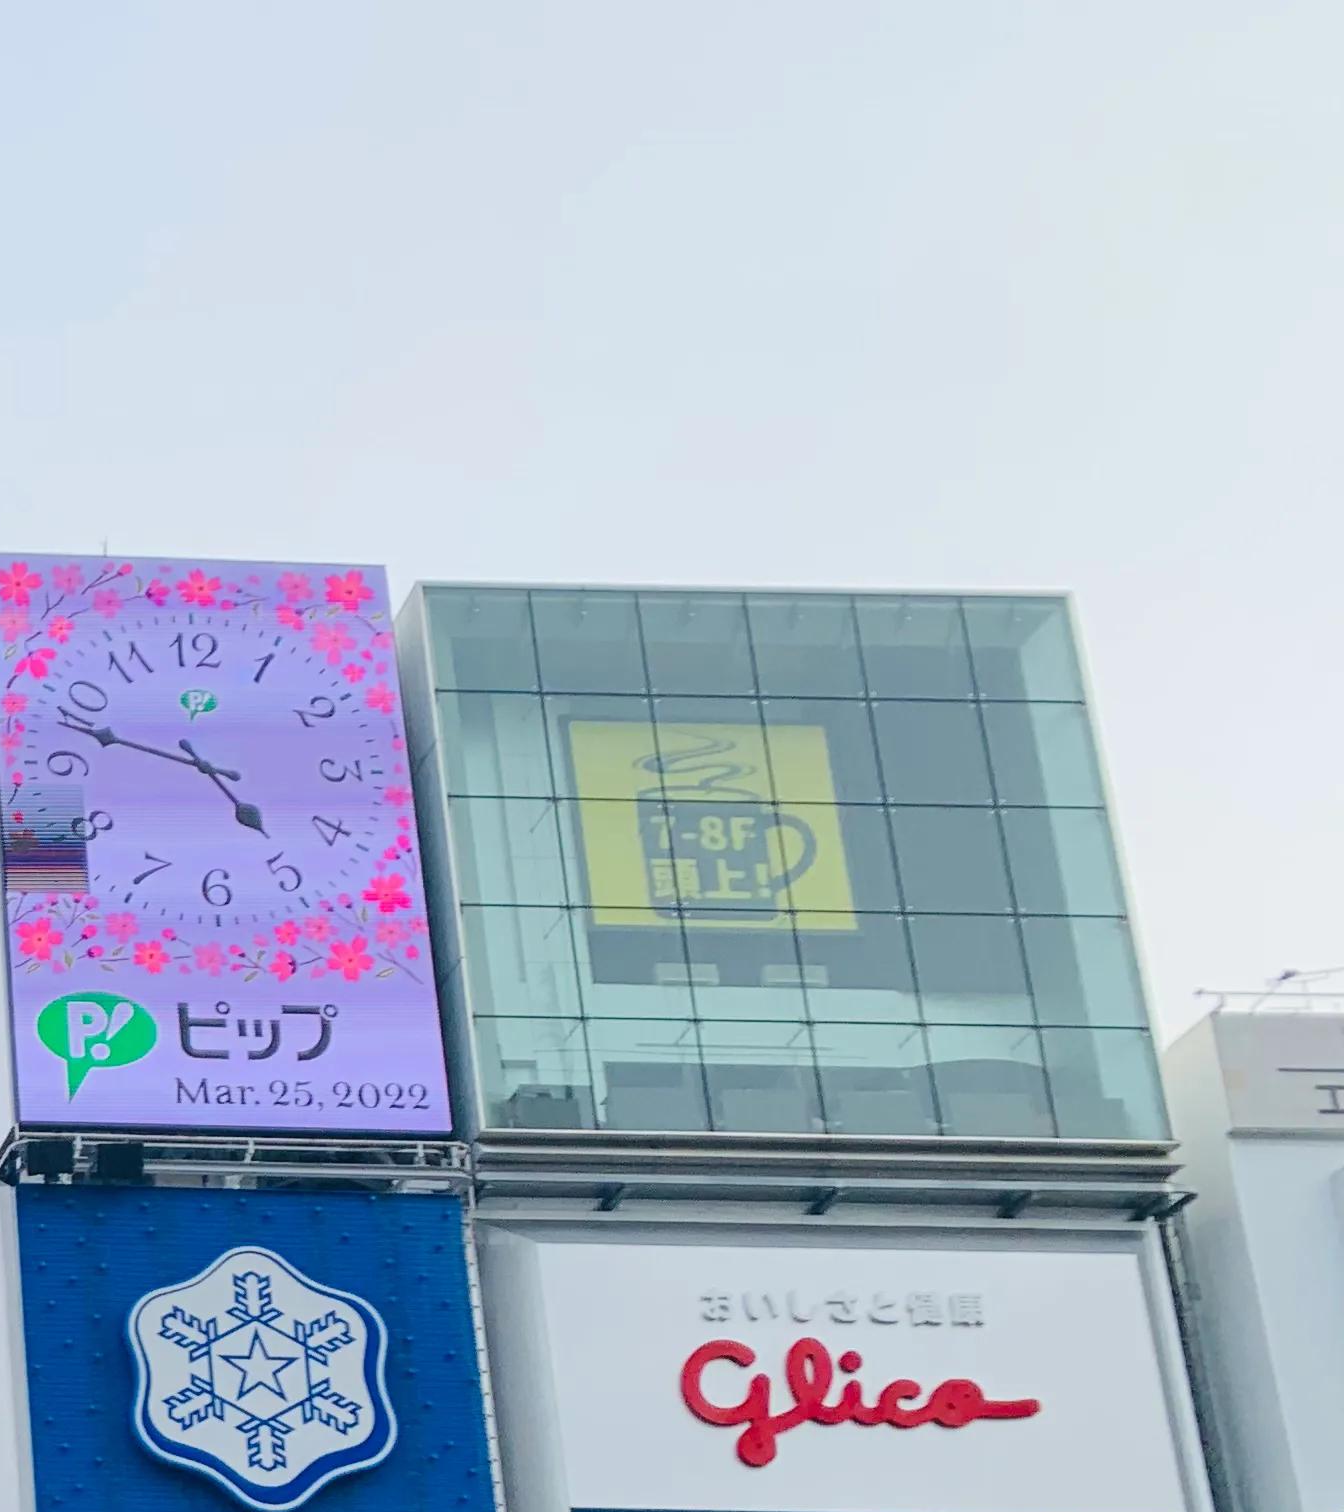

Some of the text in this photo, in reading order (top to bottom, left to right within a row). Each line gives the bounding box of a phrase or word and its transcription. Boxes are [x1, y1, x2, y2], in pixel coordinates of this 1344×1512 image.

[106, 640, 156, 684] 11
[168, 631, 221, 669] 12
[252, 651, 277, 683] 1
[296, 695, 336, 729] 2
[46, 750, 90, 778] 9
[319, 757, 363, 784] 3
[311, 812, 352, 848] 4
[650, 815, 756, 852] 7-8F
[133, 853, 173, 886] 7
[266, 850, 303, 893] 5
[201, 869, 232, 907] 6
[177, 1001, 339, 1062] ピップ
[175, 1076, 430, 1111] Mar. 25, 2022
[700, 1289, 985, 1328] おいしさと健康
